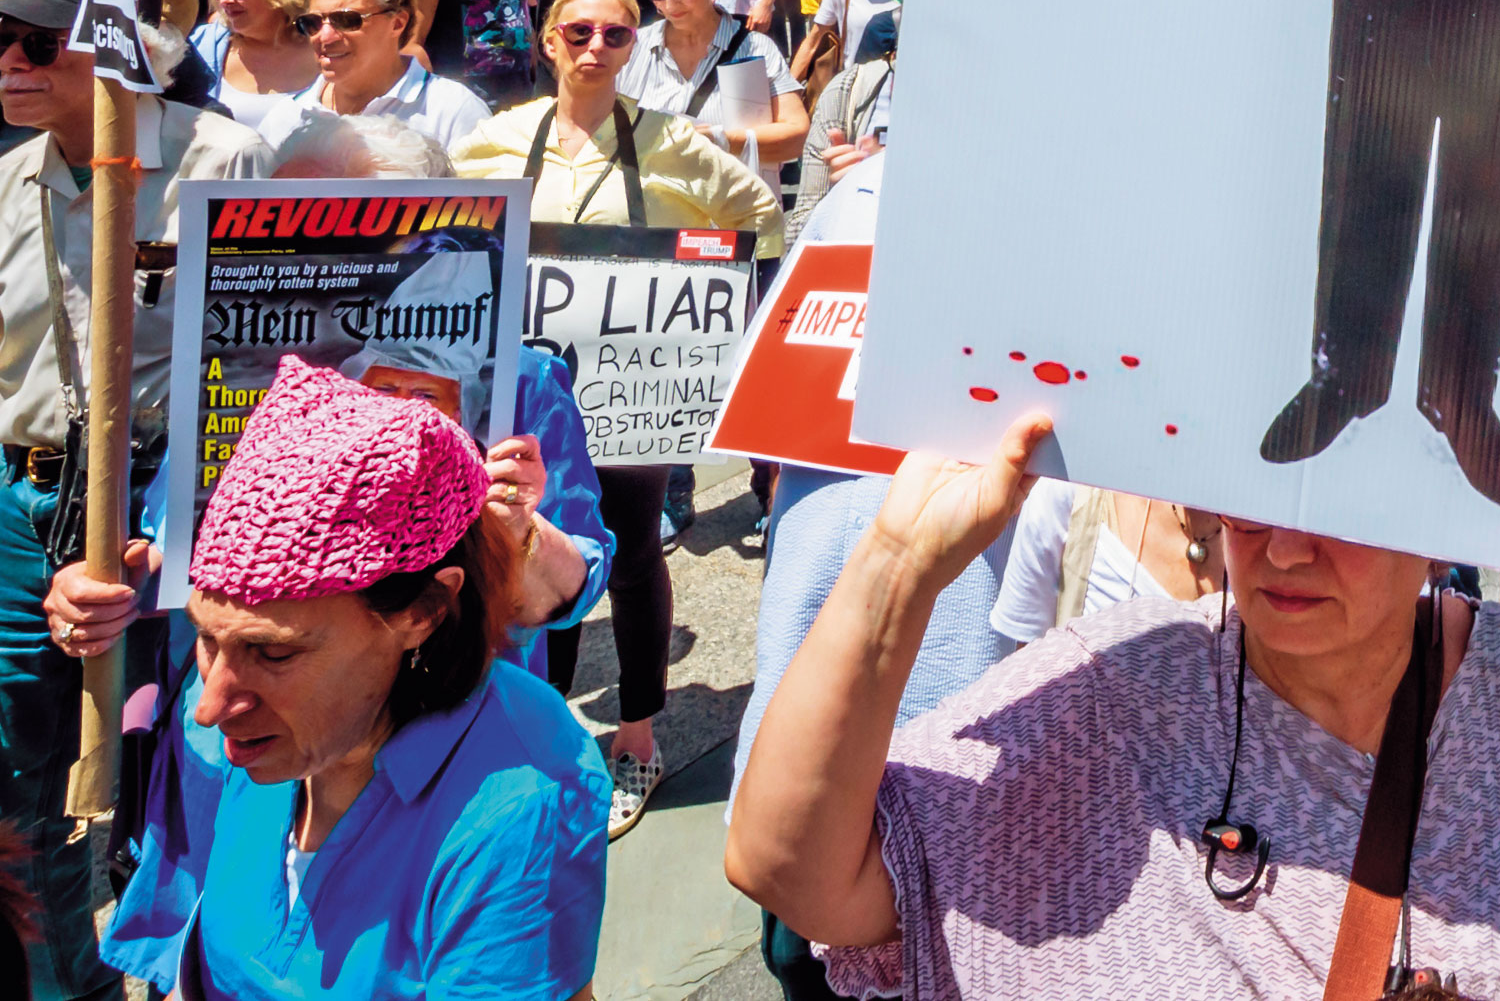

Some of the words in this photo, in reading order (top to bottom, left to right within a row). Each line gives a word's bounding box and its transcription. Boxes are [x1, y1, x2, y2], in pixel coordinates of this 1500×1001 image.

[210, 197, 505, 238] REVOLUTION
[702, 246, 731, 256] TRUMP
[210, 278, 276, 292] thoroughly
[278, 276, 314, 289] rotten
[317, 276, 359, 291] system
[211, 264, 259, 279] Brought
[262, 264, 274, 276] to
[277, 265, 299, 278] you
[303, 262, 317, 277] by
[320, 264, 328, 275] a
[332, 262, 374, 274] vicious
[377, 260, 399, 274] and
[205, 299, 319, 347] Mein
[330, 290, 494, 347] Trumpf
[600, 276, 733, 336] LIAR
[207, 357, 223, 380] A
[597, 343, 730, 374] RACIST
[579, 375, 724, 411] CRIMINAL
